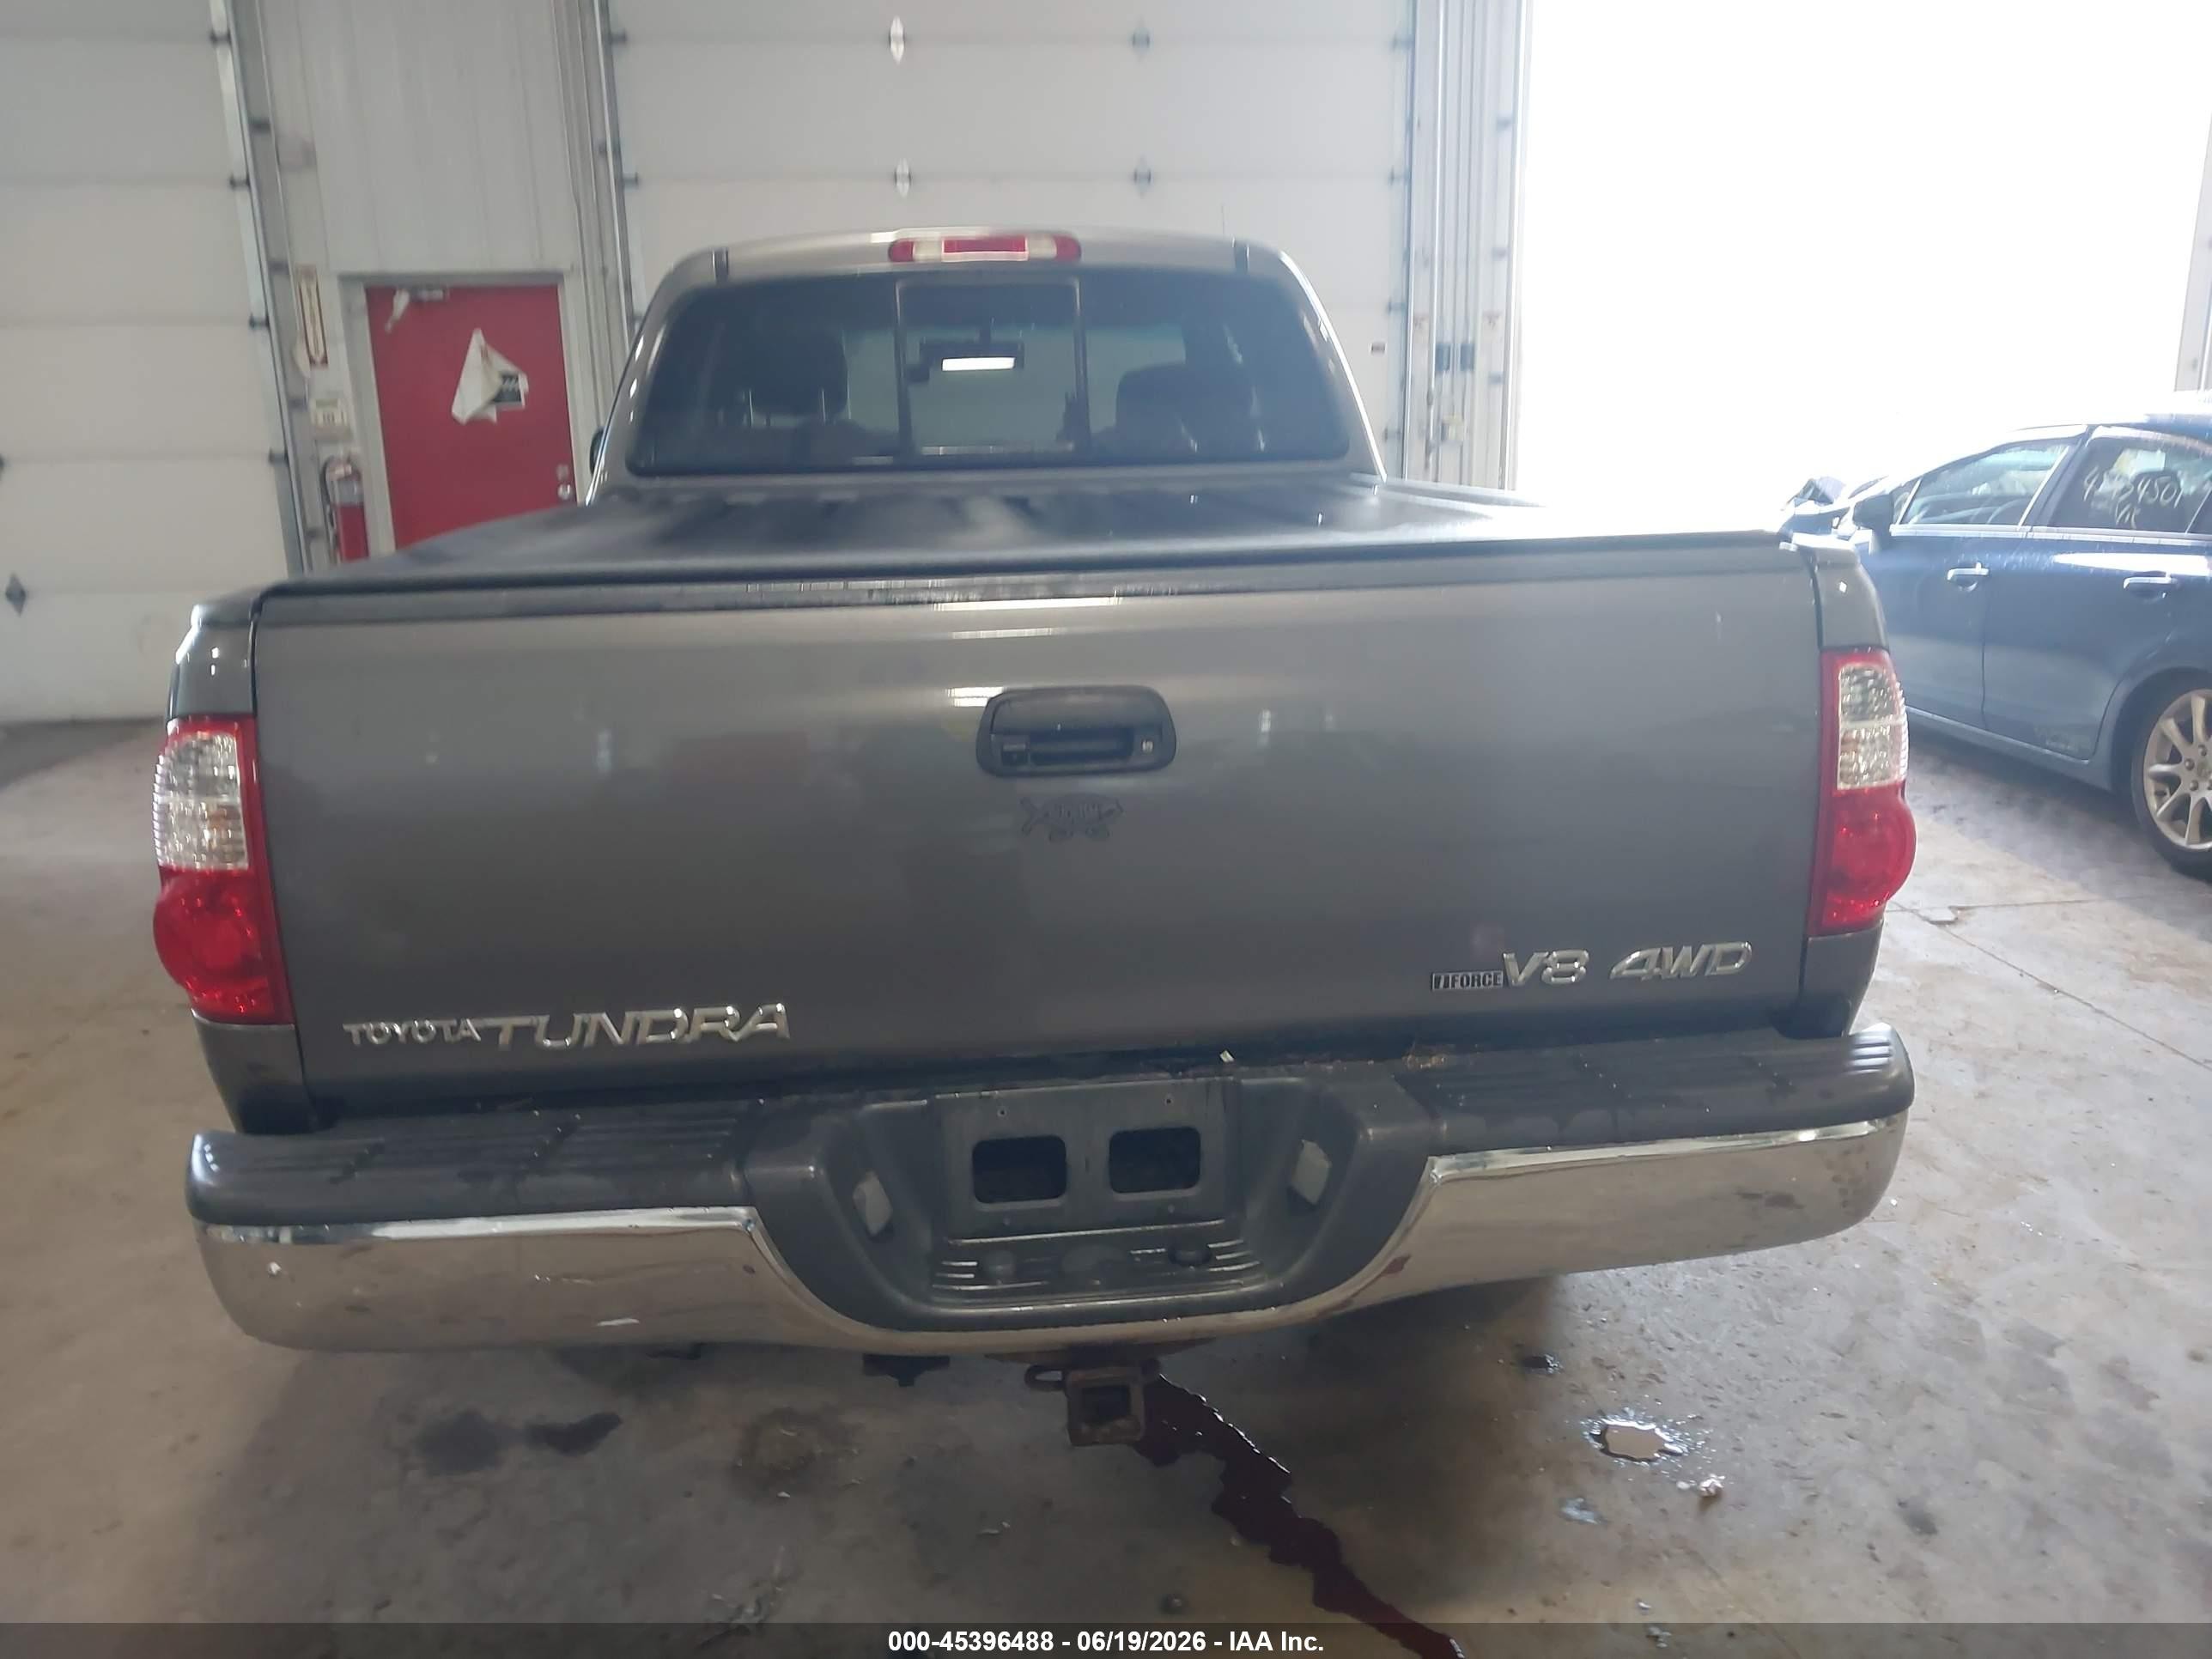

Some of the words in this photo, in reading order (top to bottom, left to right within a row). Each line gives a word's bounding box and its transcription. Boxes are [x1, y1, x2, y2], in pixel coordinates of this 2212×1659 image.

[1503, 949, 1589, 988] V8
[1610, 941, 1753, 981] 4WD
[343, 1018, 481, 1045] TOYOTA
[471, 1003, 790, 1050] TUNDRA
